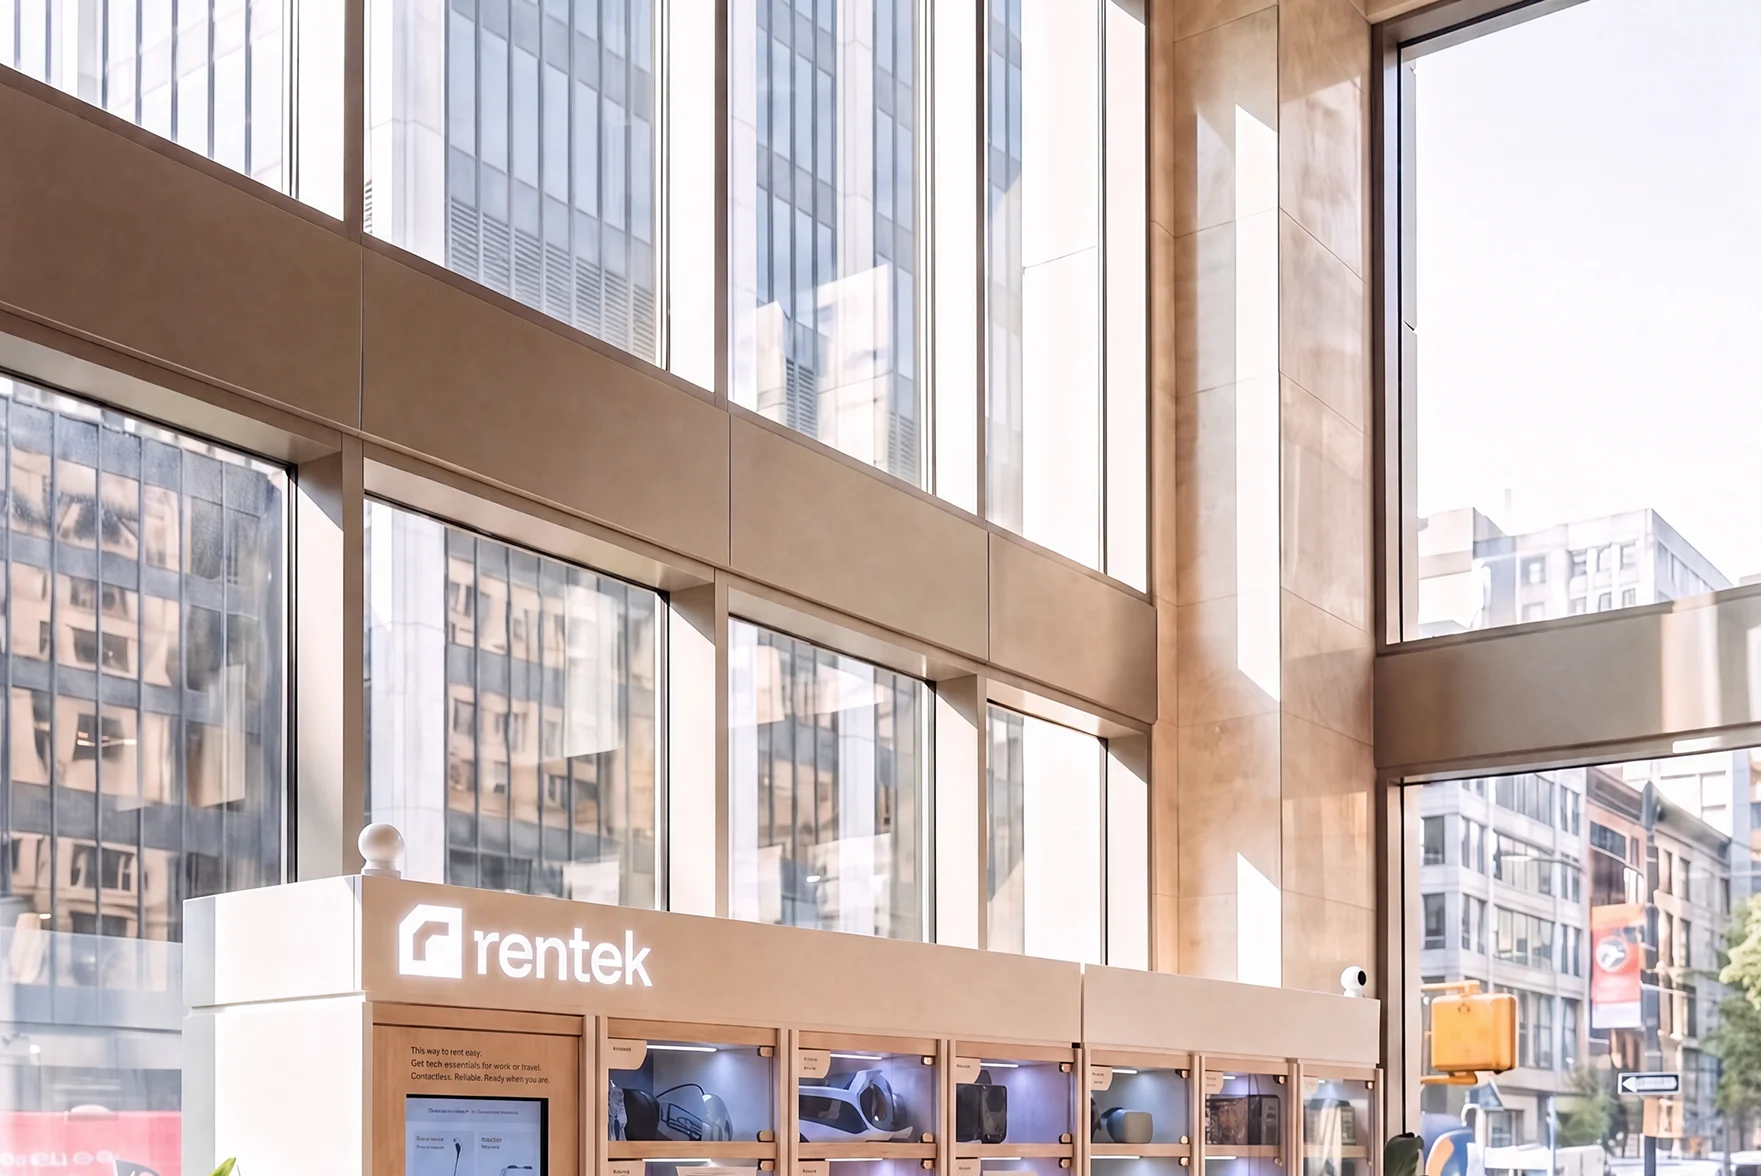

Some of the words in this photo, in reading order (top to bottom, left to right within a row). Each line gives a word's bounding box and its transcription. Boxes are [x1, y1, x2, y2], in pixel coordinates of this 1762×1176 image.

[474, 927, 653, 987] rentek
[411, 1046, 426, 1054] This
[427, 1049, 441, 1057] way
[411, 1059, 424, 1068] Get
[426, 1060, 443, 1068] tech
[444, 1061, 480, 1069] essentials
[494, 1062, 510, 1070] work
[411, 1072, 452, 1080] Contactless.
[454, 1073, 482, 1081] Reliable.
[484, 1074, 505, 1083] Ready
[506, 1075, 524, 1083] when
[524, 1076, 537, 1084] you
